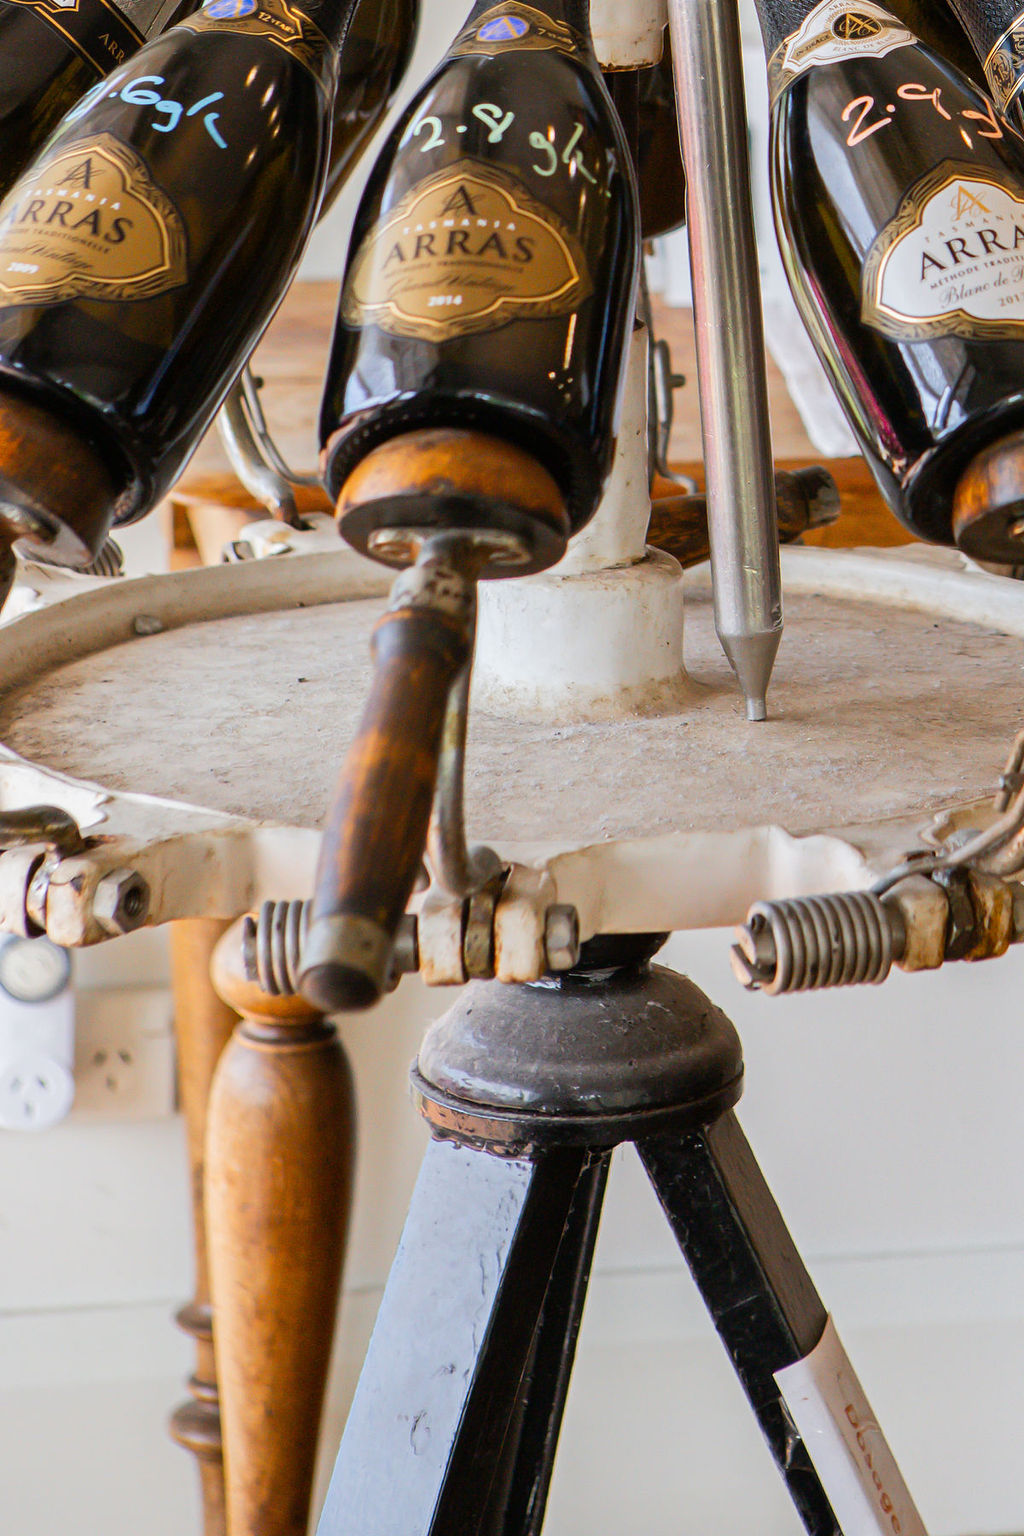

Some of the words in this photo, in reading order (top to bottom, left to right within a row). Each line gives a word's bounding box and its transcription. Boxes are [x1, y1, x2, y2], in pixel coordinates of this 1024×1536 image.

[257, 10, 272, 23] 12
[413, 102, 516, 153] 2.8
[402, 218, 517, 236] TASMANIA
[381, 229, 536, 269] ARRAS
[939, 284, 991, 310] Blanc
[992, 271, 1011, 288] de
